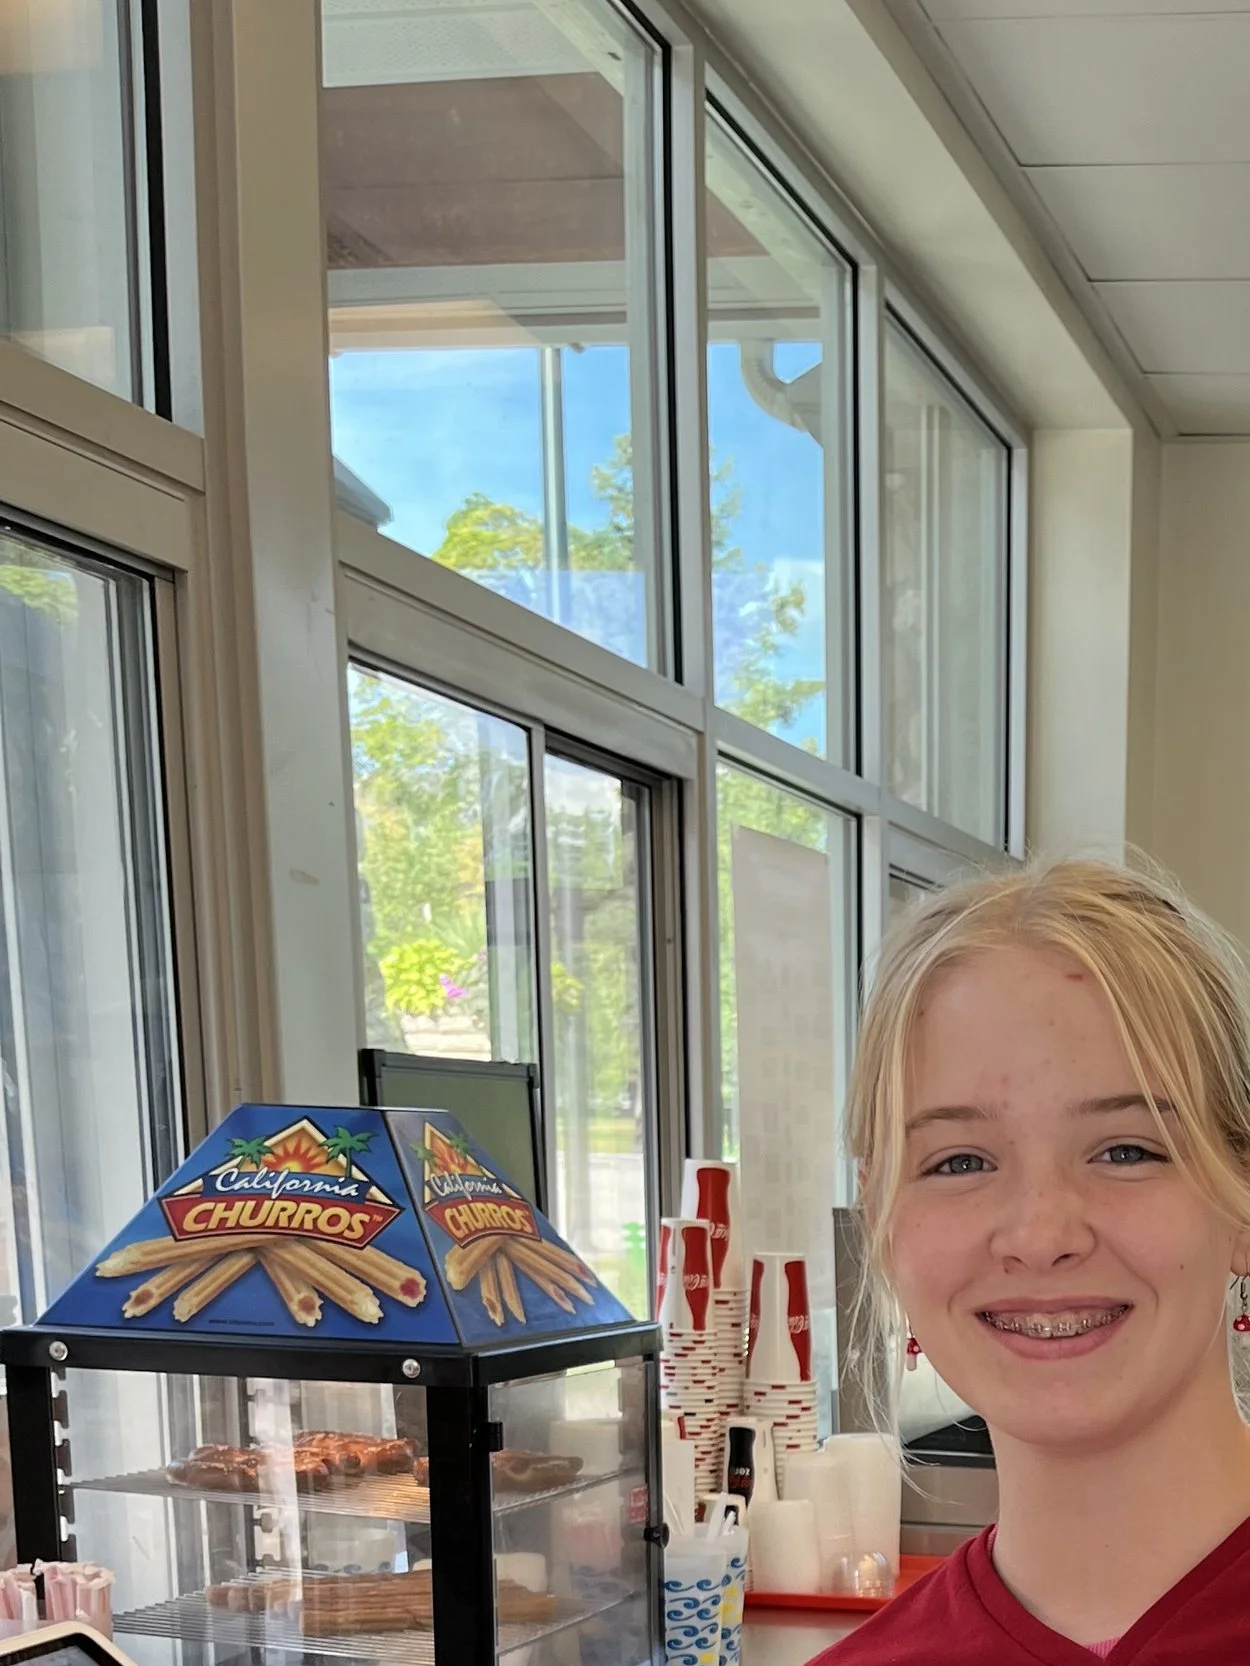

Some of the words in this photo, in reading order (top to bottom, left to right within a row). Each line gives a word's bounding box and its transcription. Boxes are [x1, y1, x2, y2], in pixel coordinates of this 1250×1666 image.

[216, 1166, 360, 1200] California
[430, 1170, 503, 1201] California
[182, 1201, 371, 1240] CHURROS
[444, 1202, 533, 1239] CHURROS
